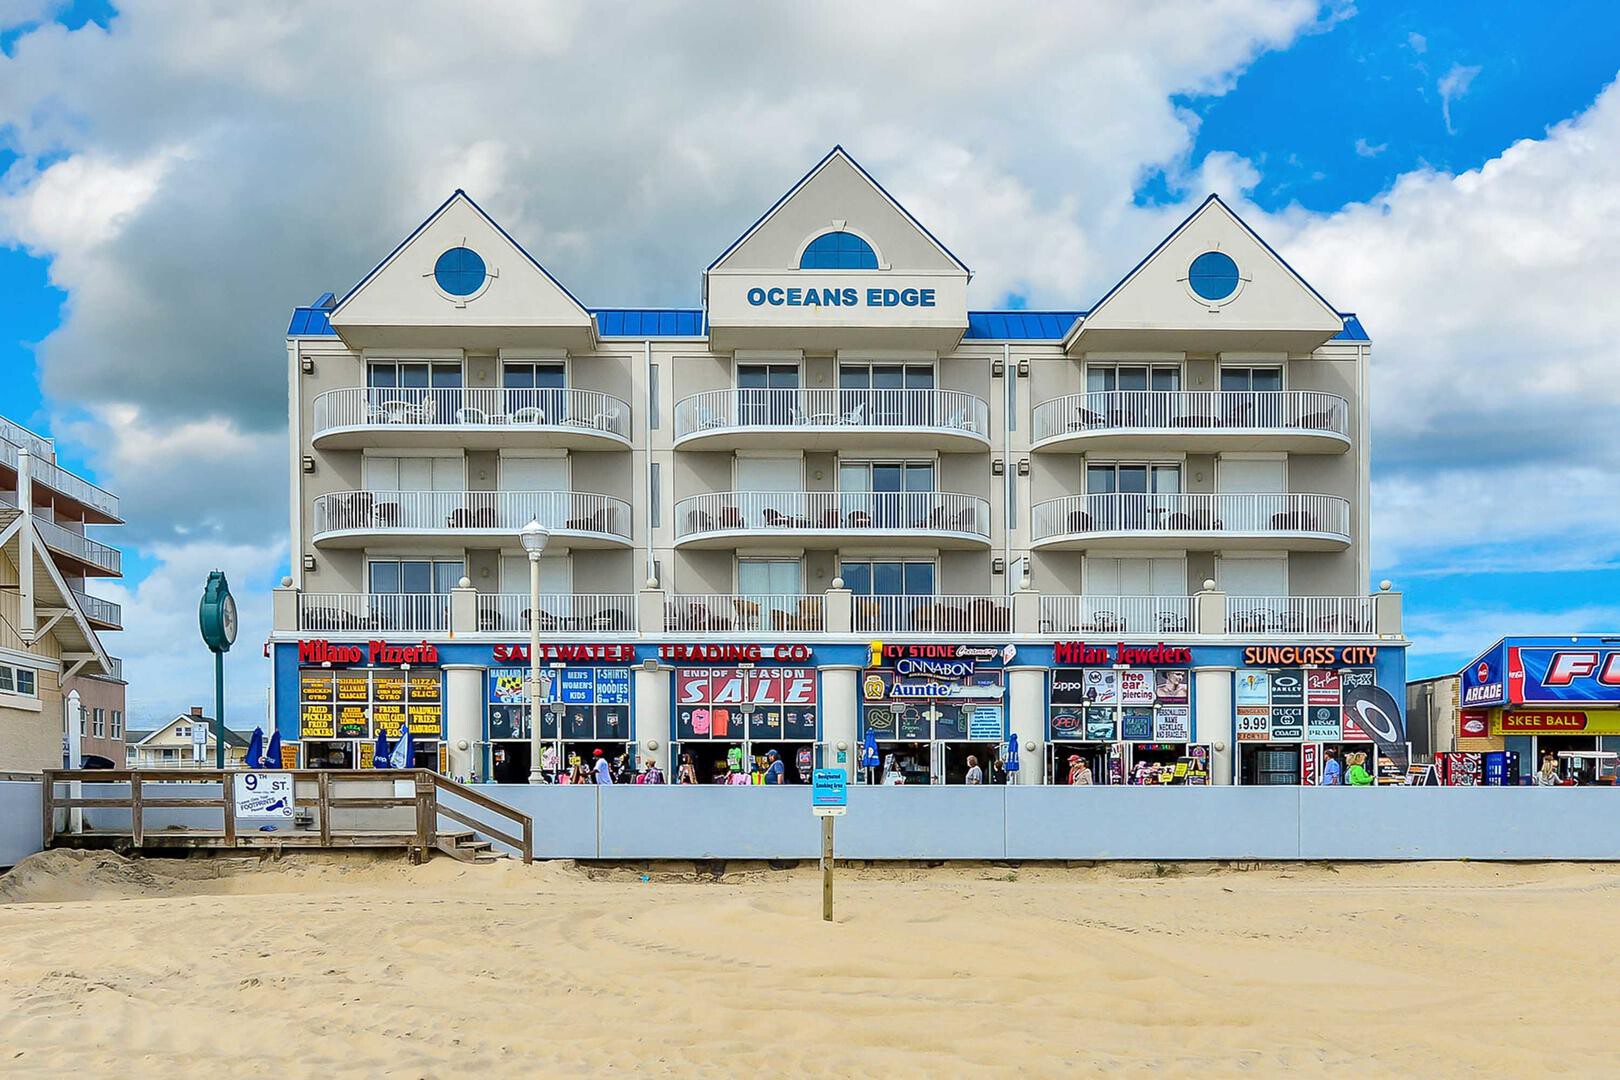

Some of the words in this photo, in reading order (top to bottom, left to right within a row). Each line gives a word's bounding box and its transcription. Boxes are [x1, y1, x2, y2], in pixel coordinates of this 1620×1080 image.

[747, 287, 858, 307] OCEANS
[866, 288, 936, 307] EDGE
[298, 640, 361, 662] Milano
[368, 640, 438, 663] Pizzeria
[660, 644, 762, 662] TRADING
[910, 646, 955, 658] STONE
[956, 645, 998, 658] Creamery
[1054, 641, 1108, 664] Milan
[1116, 642, 1192, 664] Jewelers
[1244, 646, 1336, 664] SUNGLASS
[1342, 646, 1377, 664] CITY
[526, 670, 556, 678] FAG
[683, 670, 708, 678] END
[712, 670, 728, 678] OF
[736, 670, 805, 678] SEASON
[896, 659, 974, 676] CINNABON
[1122, 671, 1144, 681] free
[597, 683, 628, 694] HOODIES
[680, 678, 813, 703] SALE
[892, 683, 949, 696] Auntie
[1053, 681, 1081, 692] zippo
[1465, 683, 1502, 702] ARCADE
[570, 692, 586, 700] KIDS
[1122, 690, 1152, 700] piercing
[413, 715, 436, 723] FRIES
[1239, 717, 1267, 730] $9.99
[1508, 715, 1541, 726] SKEE
[1546, 715, 1579, 726] BALL
[272, 781, 289, 790] ST.
[240, 797, 276, 811] FOOTPRINTS
